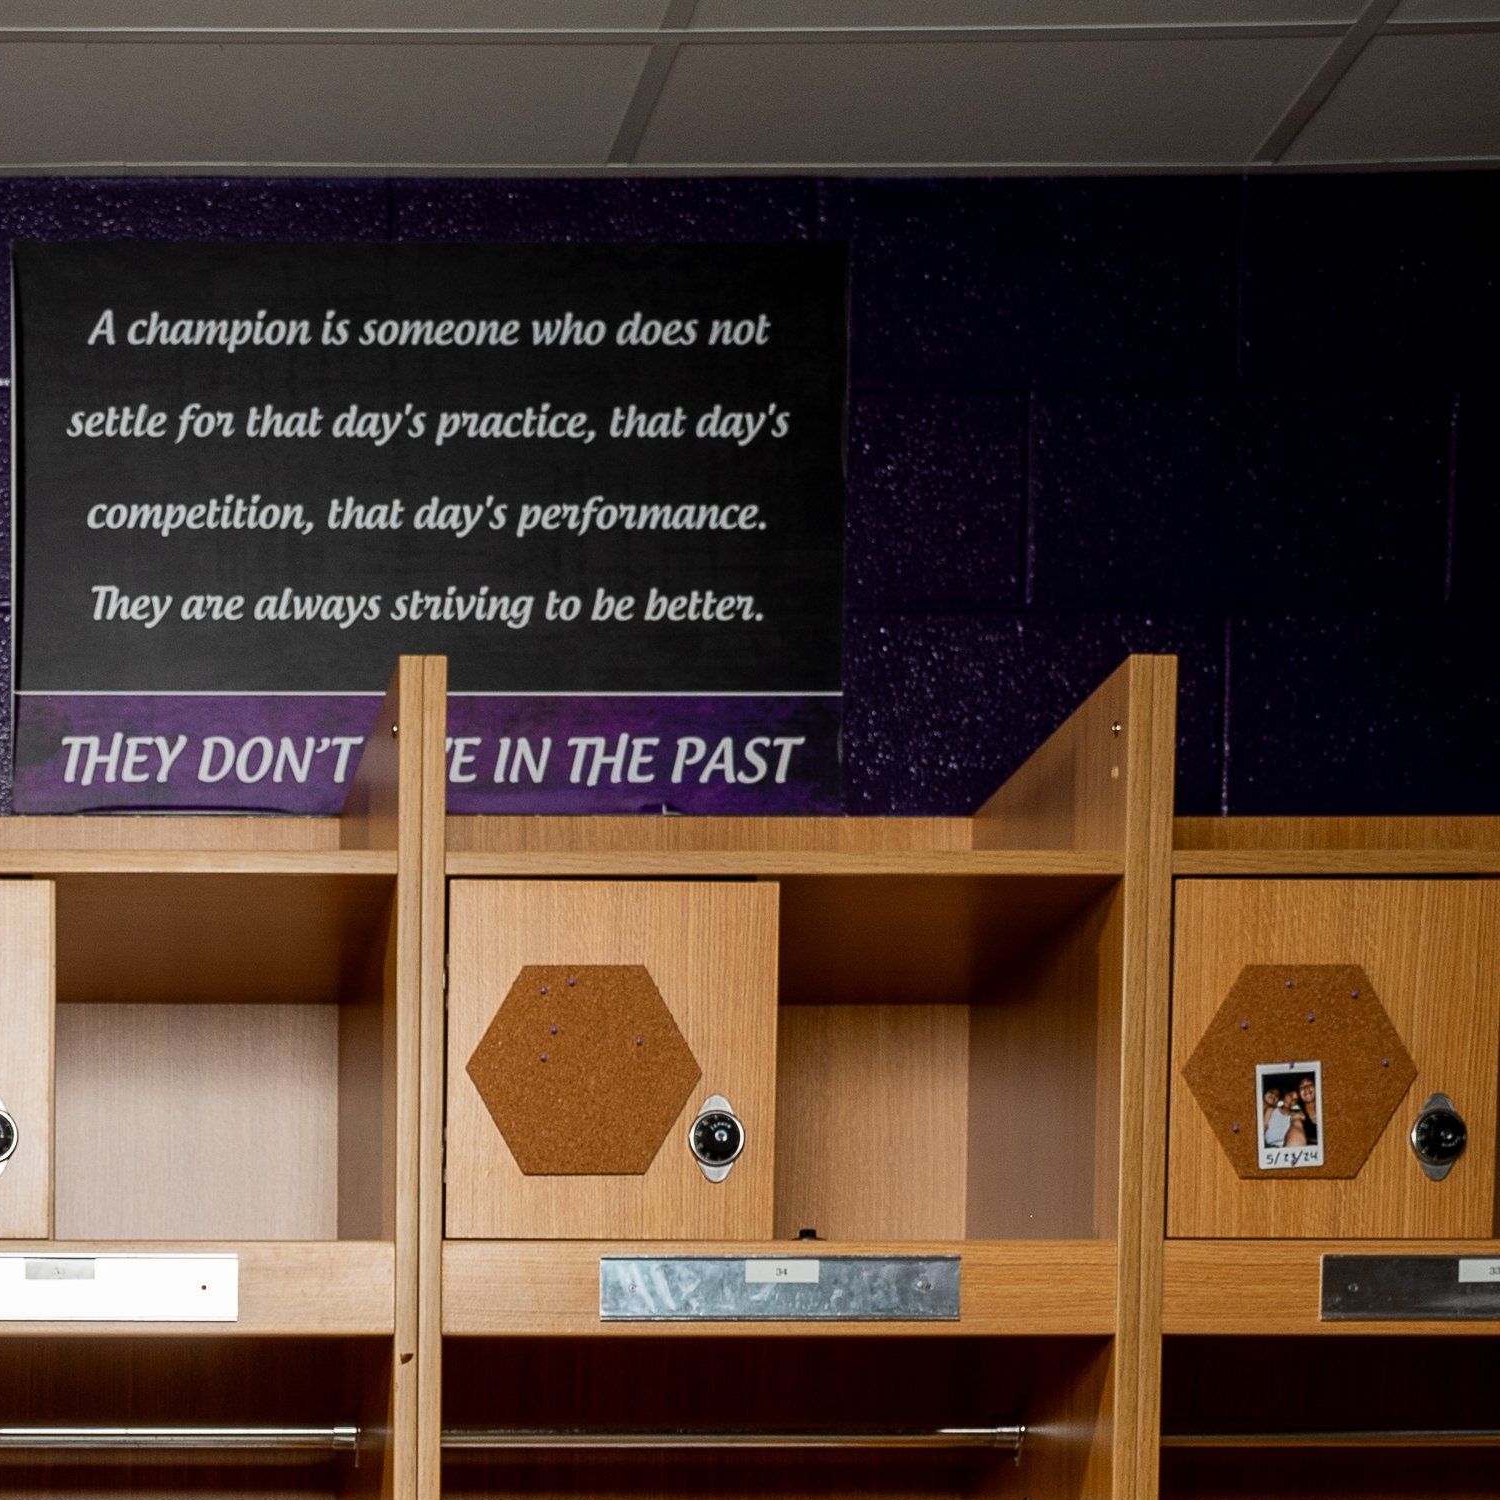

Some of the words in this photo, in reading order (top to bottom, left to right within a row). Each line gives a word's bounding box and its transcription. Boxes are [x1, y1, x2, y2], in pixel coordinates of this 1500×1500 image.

[87, 310, 116, 346] A
[127, 310, 312, 354] champion
[321, 310, 350, 346] is
[358, 319, 520, 346] someone
[532, 312, 606, 346] who
[616, 312, 698, 346] does
[708, 314, 771, 346] not
[66, 403, 168, 438] settle
[175, 402, 235, 444] for
[246, 404, 324, 438] that
[332, 403, 427, 447] day's
[435, 402, 596, 446] practice,
[609, 404, 687, 438] that
[695, 403, 790, 447] day's
[86, 493, 314, 538] competition,
[327, 495, 405, 530] that
[413, 495, 508, 539] day's
[516, 495, 767, 538] performance.
[91, 584, 172, 630] They
[181, 594, 245, 622] are
[253, 586, 382, 630] always
[390, 585, 535, 630] striving
[545, 590, 582, 621] to
[591, 587, 635, 621] be
[644, 587, 764, 622] better.
[61, 731, 189, 787] THEY
[197, 735, 364, 784] DON'T
[493, 736, 552, 784] IN
[567, 732, 660, 787] THE
[671, 736, 804, 784] PAST
